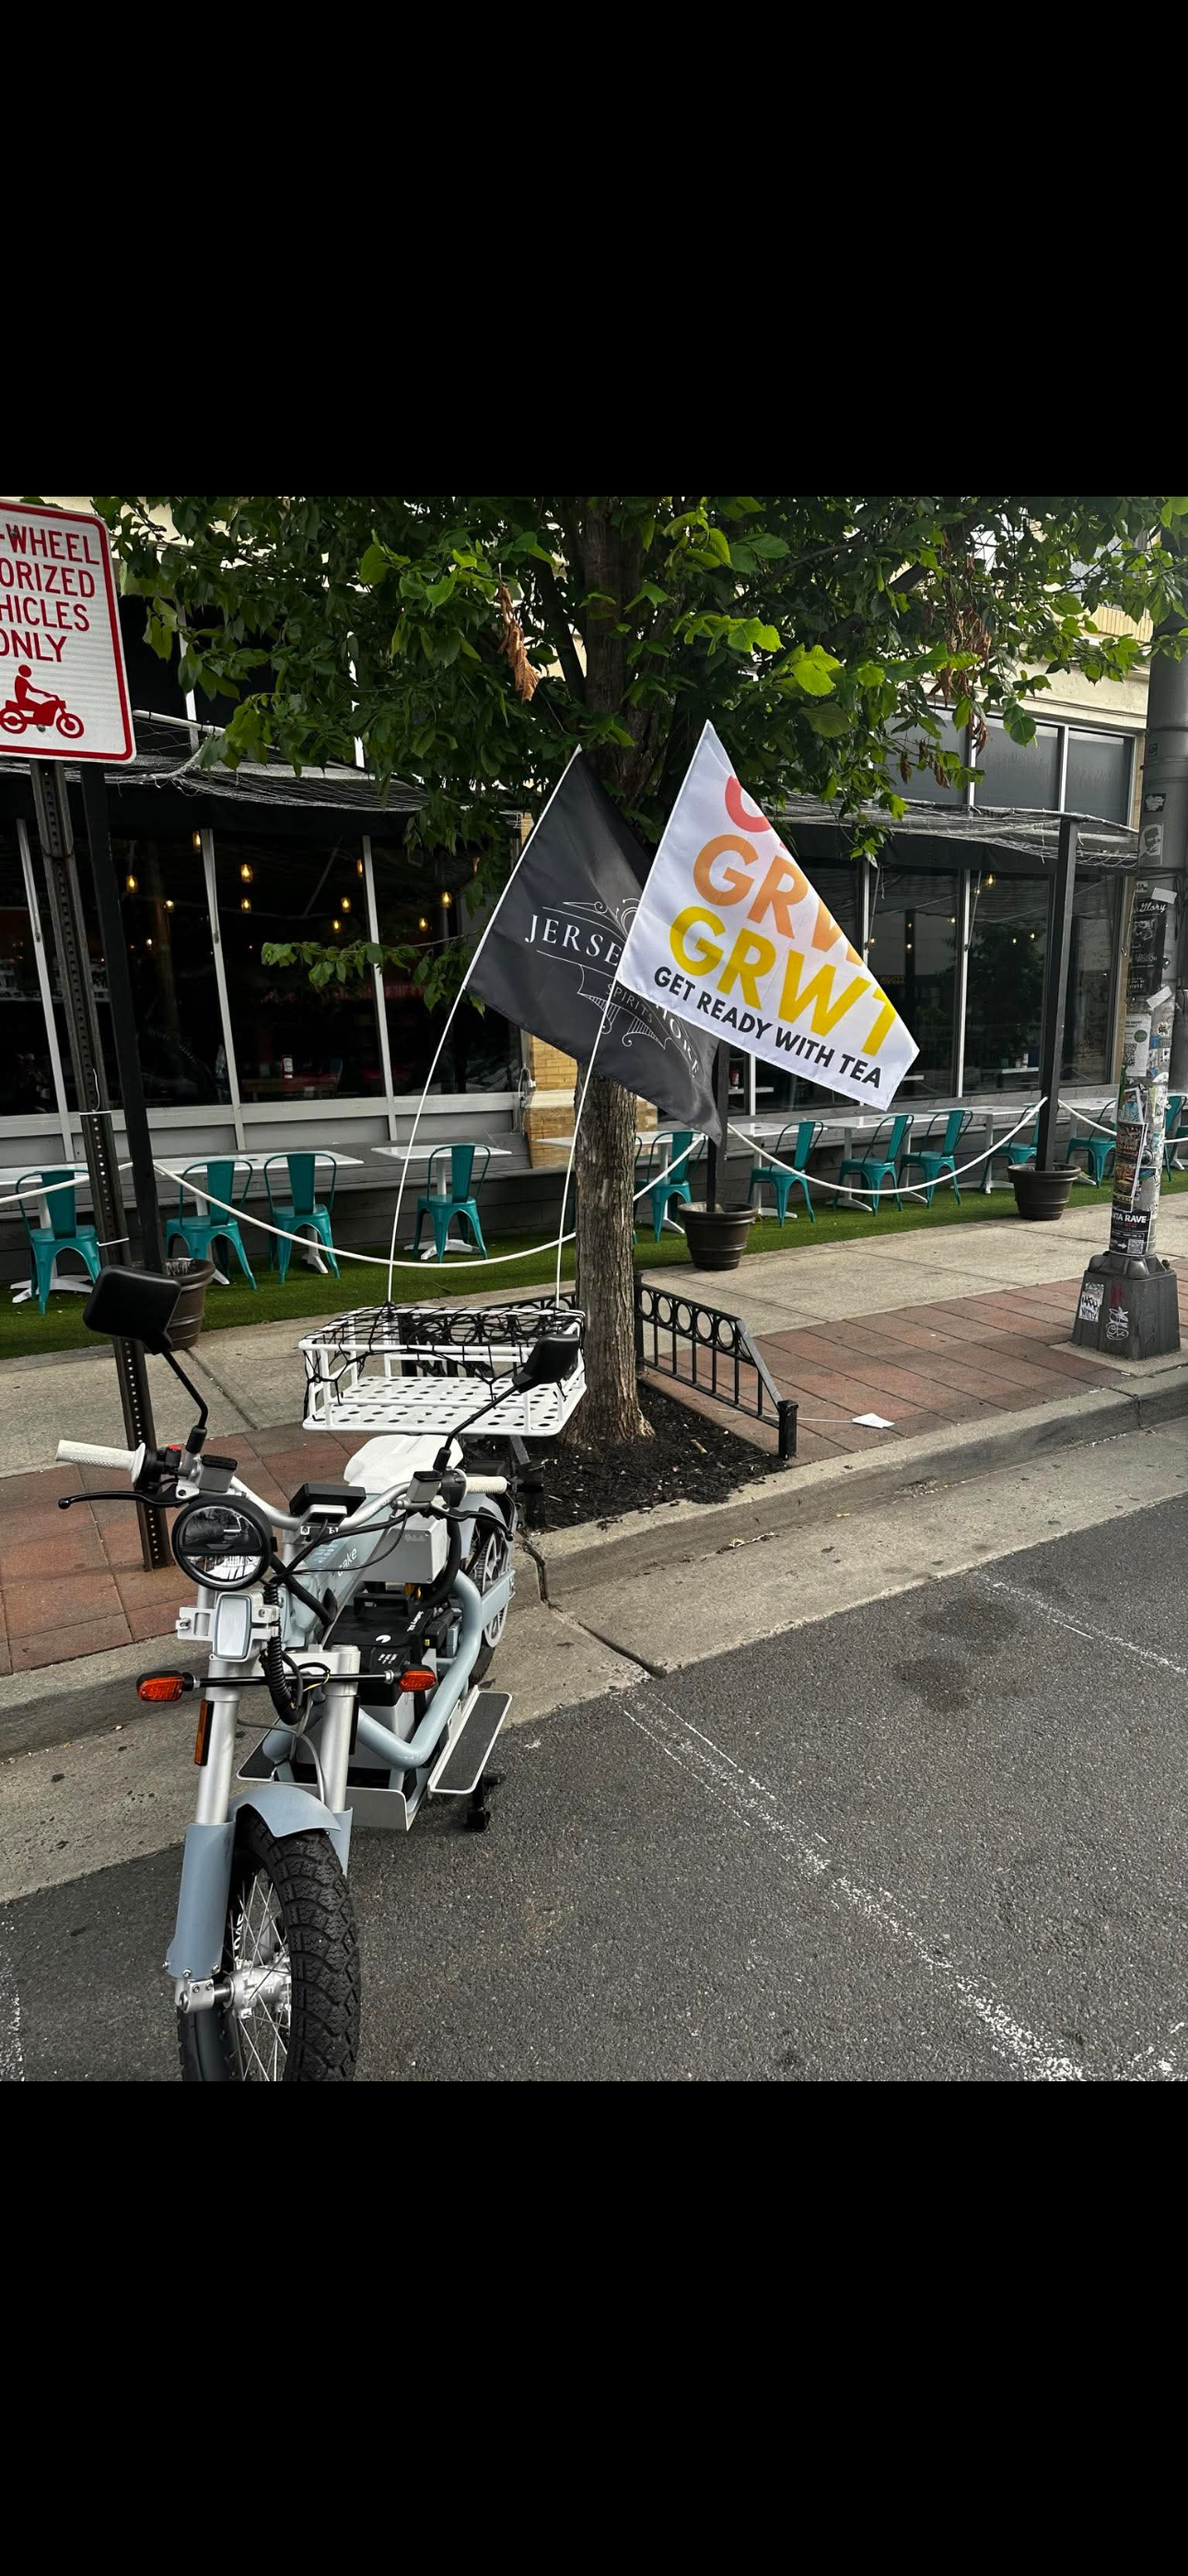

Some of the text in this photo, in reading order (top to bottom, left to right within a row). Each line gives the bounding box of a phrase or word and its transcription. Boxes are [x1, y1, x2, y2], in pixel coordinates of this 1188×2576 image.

[0, 557, 96, 598] ORIZED
[606, 983, 653, 1024] SPIRITS
[654, 966, 881, 1089] GET READY WITH TEA
[1124, 1214, 1147, 1224] RAVE
